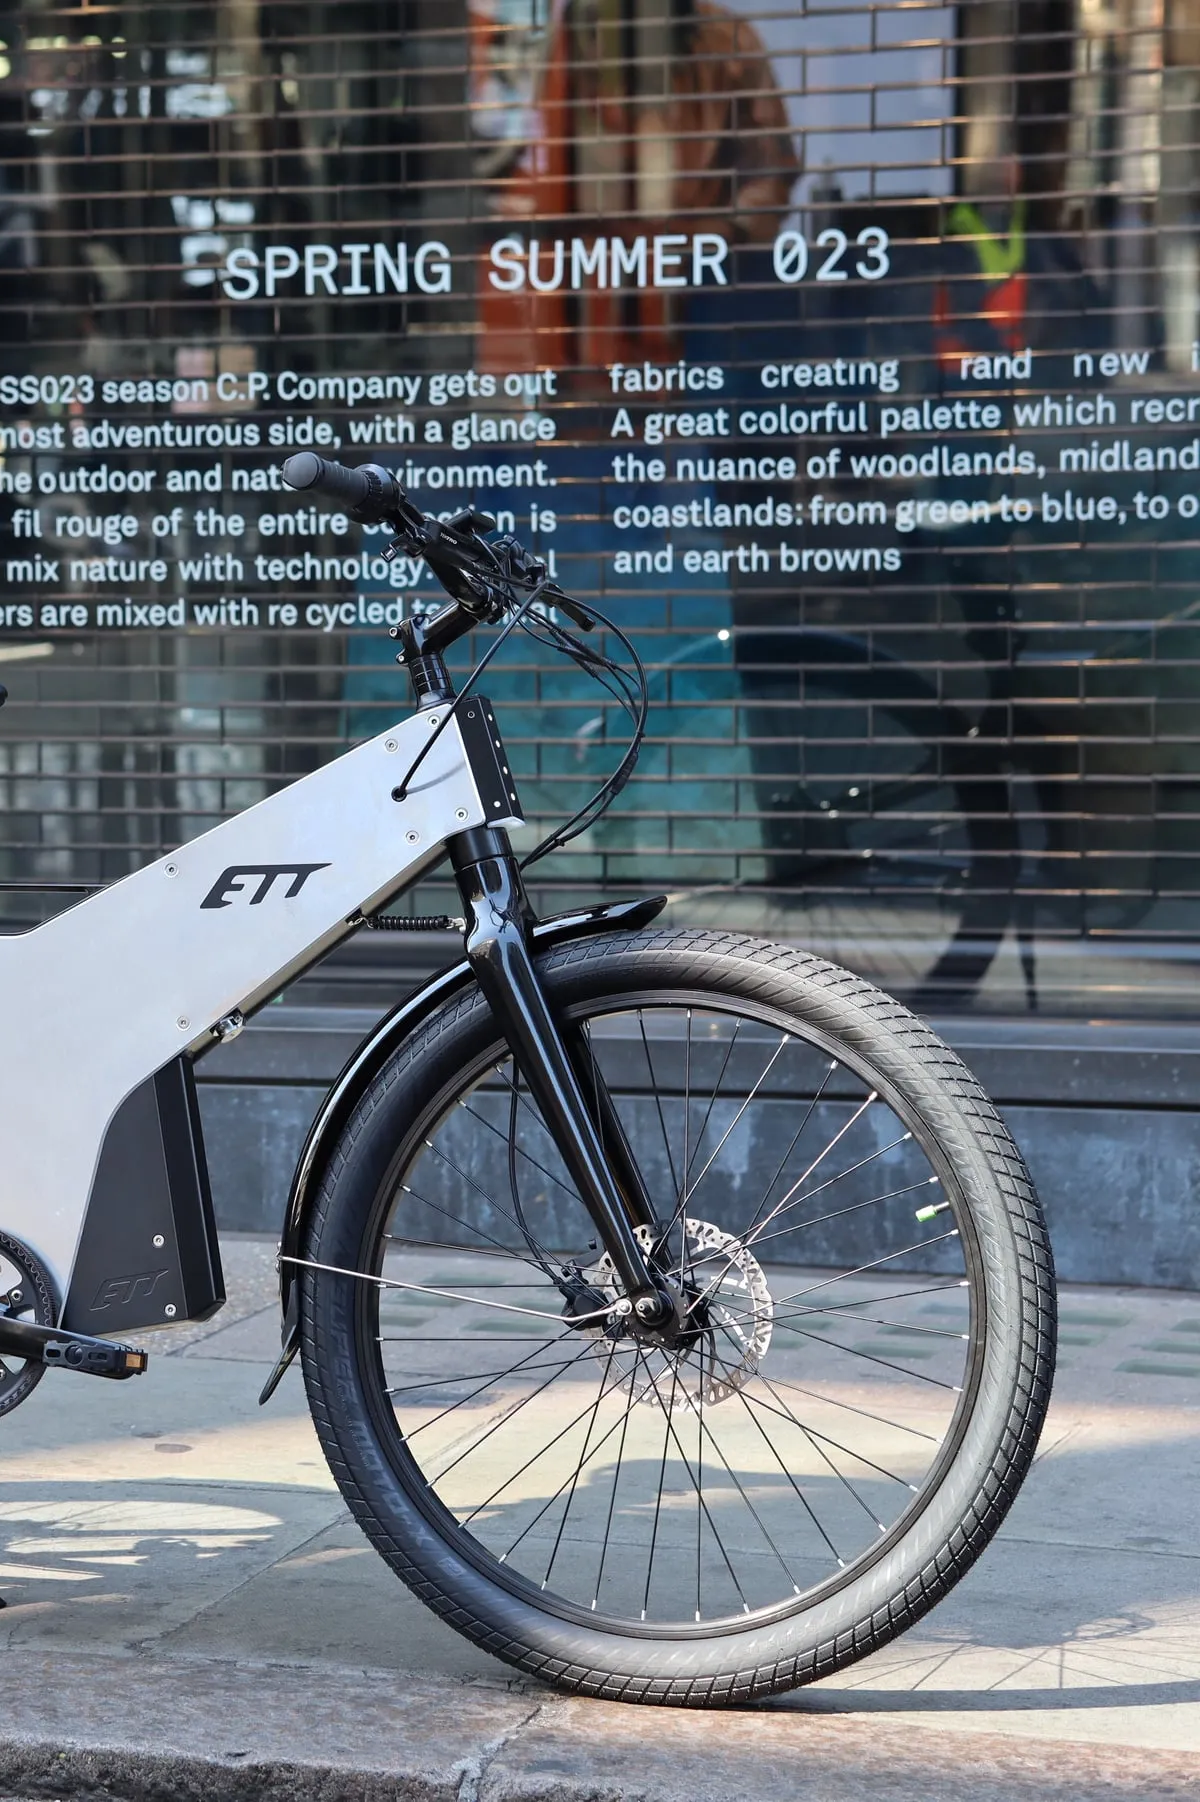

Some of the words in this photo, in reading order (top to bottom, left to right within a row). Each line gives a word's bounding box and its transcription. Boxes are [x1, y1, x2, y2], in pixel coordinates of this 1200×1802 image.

[222, 239, 453, 300] SPRING
[488, 232, 729, 294] SUMMER
[773, 225, 892, 284] 023
[0, 375, 95, 404] SS023
[102, 380, 209, 403] season
[217, 372, 270, 402] C.P.
[277, 371, 421, 406] Company
[428, 370, 496, 405] gets
[503, 368, 557, 397] out
[609, 360, 725, 393] fabrics
[761, 358, 900, 393] creating
[72, 419, 260, 448] adventurous
[268, 415, 341, 449] side,
[349, 414, 415, 444] with
[424, 420, 443, 443] a
[451, 413, 557, 450] glance
[610, 408, 634, 437] A
[643, 408, 730, 445] great
[739, 401, 868, 434] colorful
[880, 399, 1001, 437] palette
[1013, 393, 1116, 426] which
[38, 464, 157, 493] outdoor
[166, 463, 222, 492] and
[612, 452, 665, 482] the
[676, 456, 796, 481] nuance
[806, 448, 841, 479] of
[850, 443, 1045, 478] woodlands,
[1059, 439, 1200, 473] midland
[12, 508, 42, 538] fil
[55, 513, 138, 545] rouge
[152, 507, 183, 537] of
[194, 508, 245, 537] the
[258, 506, 348, 536] entire
[530, 503, 557, 533] is
[613, 496, 803, 528] coastlands:
[808, 495, 886, 526] from
[895, 499, 990, 532] green
[1000, 494, 1032, 523] to
[1041, 490, 1127, 525] blue,
[1132, 491, 1169, 520] to
[6, 555, 59, 582] mix
[70, 557, 167, 582] nature
[178, 552, 243, 582] with
[255, 550, 433, 588] technology.
[613, 543, 673, 574] and
[683, 542, 770, 573] earth
[780, 541, 901, 572] browns
[40, 604, 88, 627] are
[97, 598, 185, 627] mixed
[193, 597, 258, 626] with
[200, 862, 333, 909] ETT
[90, 1268, 170, 1311] ETT
